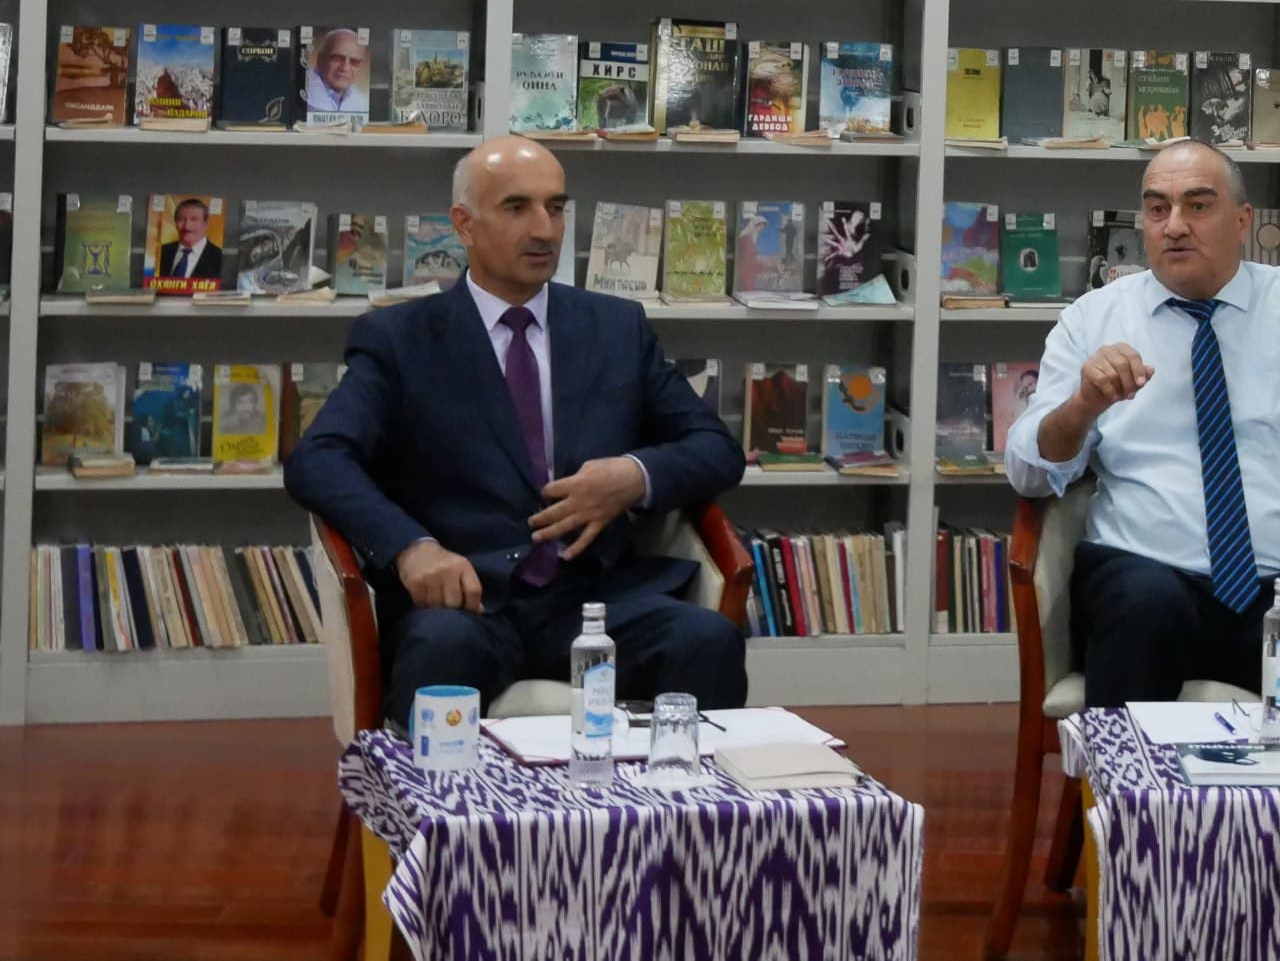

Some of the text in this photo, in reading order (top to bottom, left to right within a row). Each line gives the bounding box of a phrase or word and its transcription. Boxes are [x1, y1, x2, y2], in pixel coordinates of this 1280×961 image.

[241, 47, 274, 55] СОРБОН
[592, 64, 637, 78] ХИРС
[400, 110, 463, 124] БХОРО
[748, 114, 793, 123] ГАРДИШИ
[751, 123, 789, 132] ДЕВБОД
